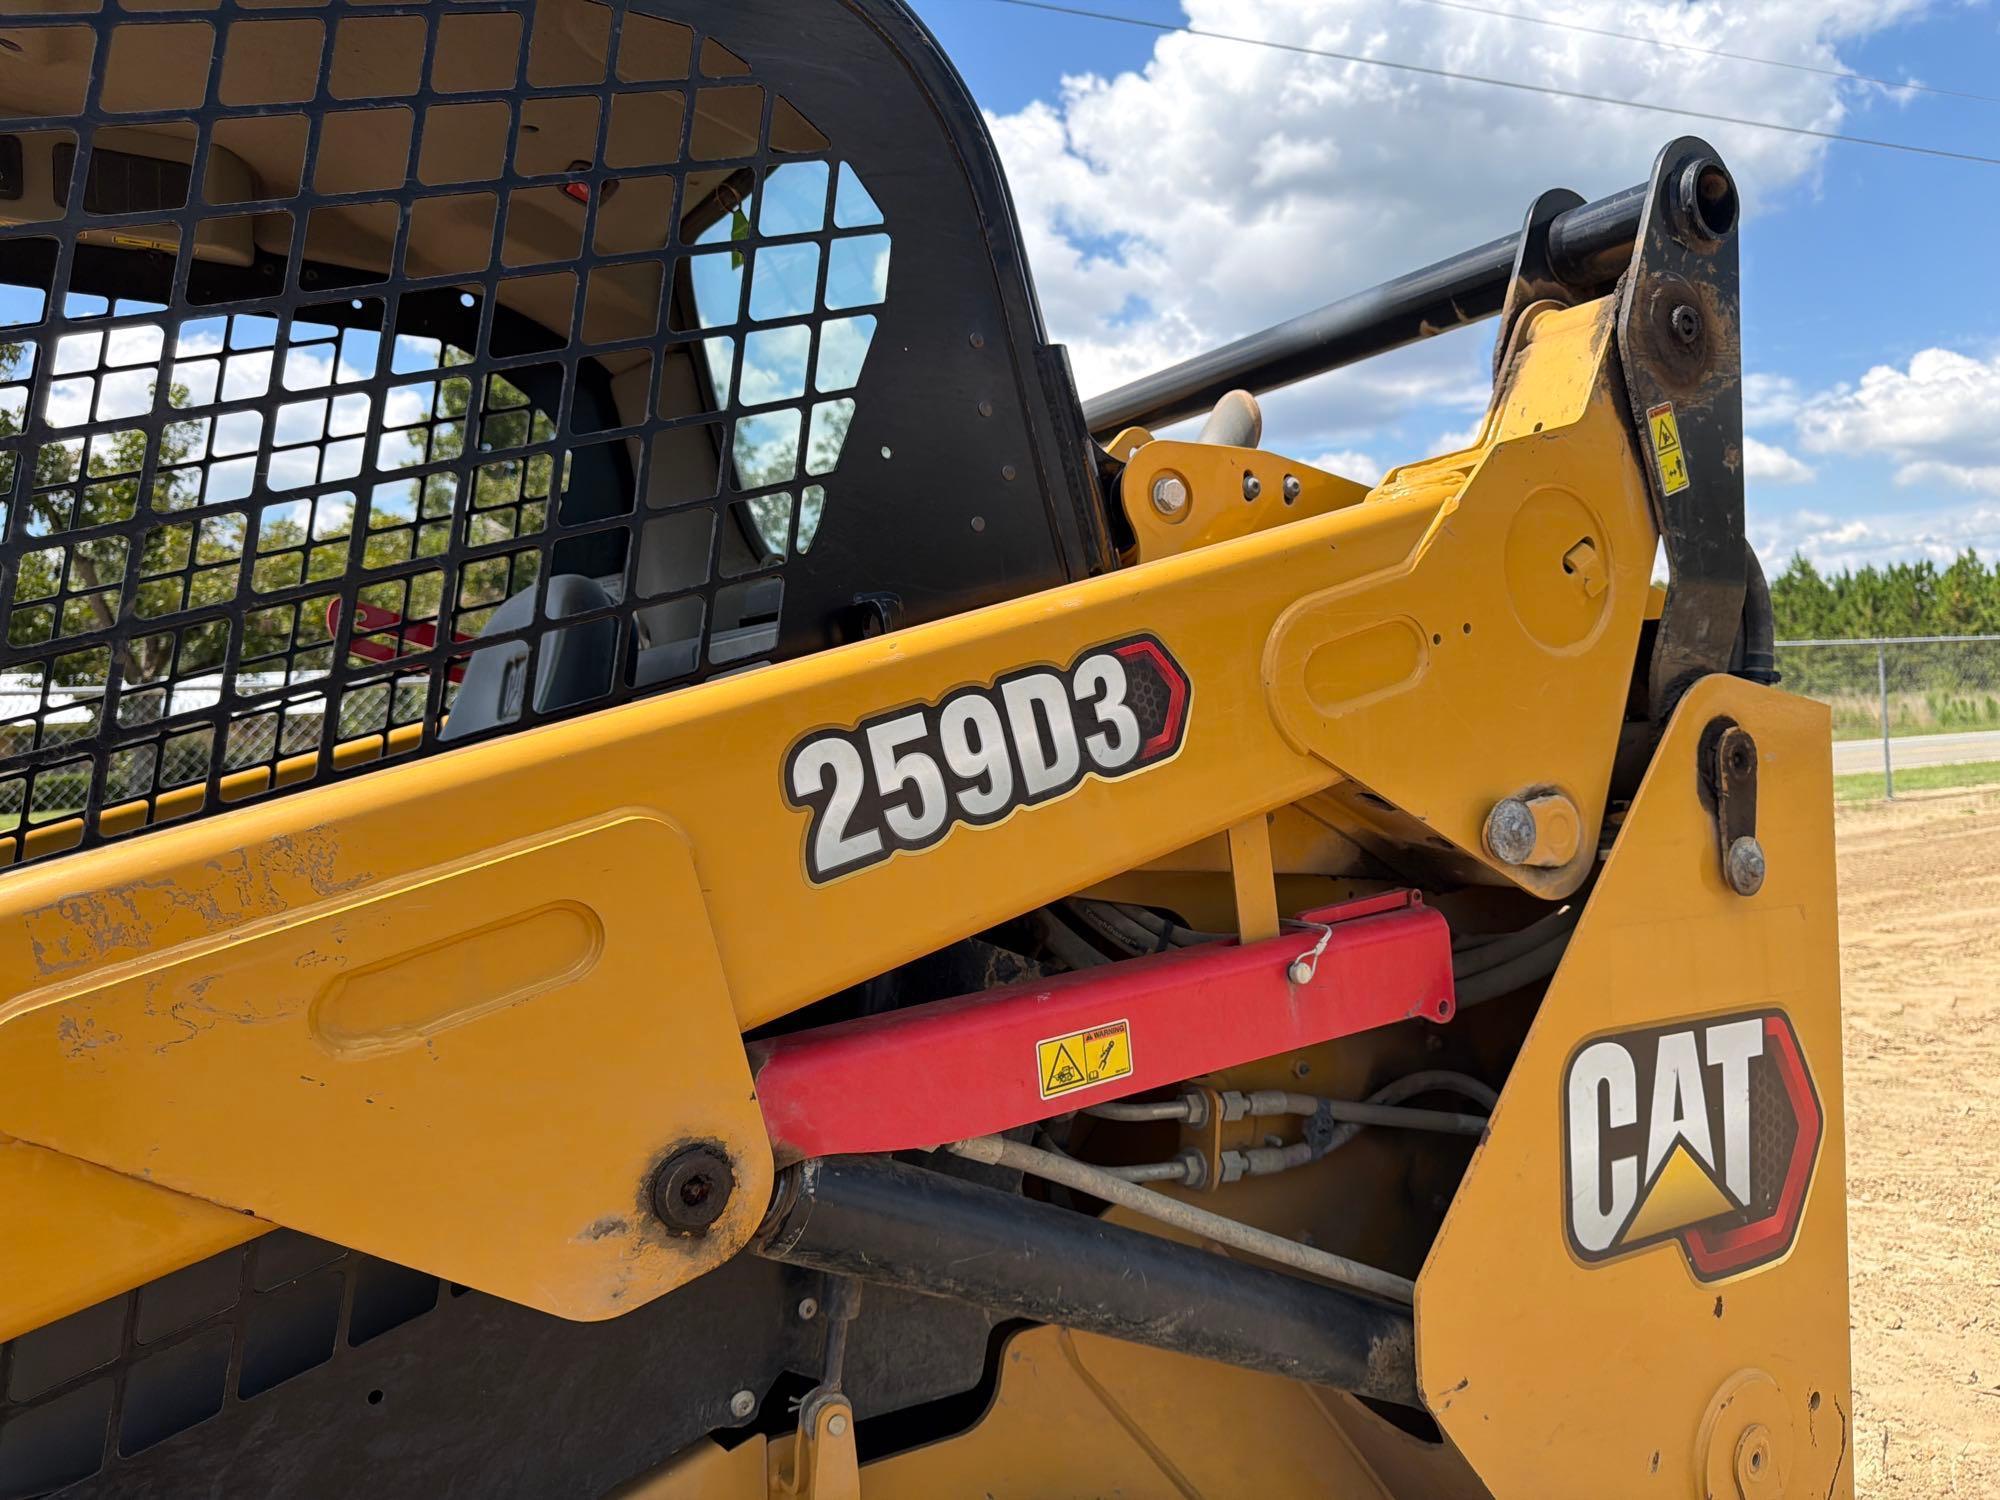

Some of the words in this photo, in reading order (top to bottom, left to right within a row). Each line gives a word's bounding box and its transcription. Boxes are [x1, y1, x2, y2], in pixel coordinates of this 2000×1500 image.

[792, 654, 1140, 874] 259D3
[1094, 1025, 1125, 1038] WARNING
[1569, 1018, 1763, 1251] CAT
